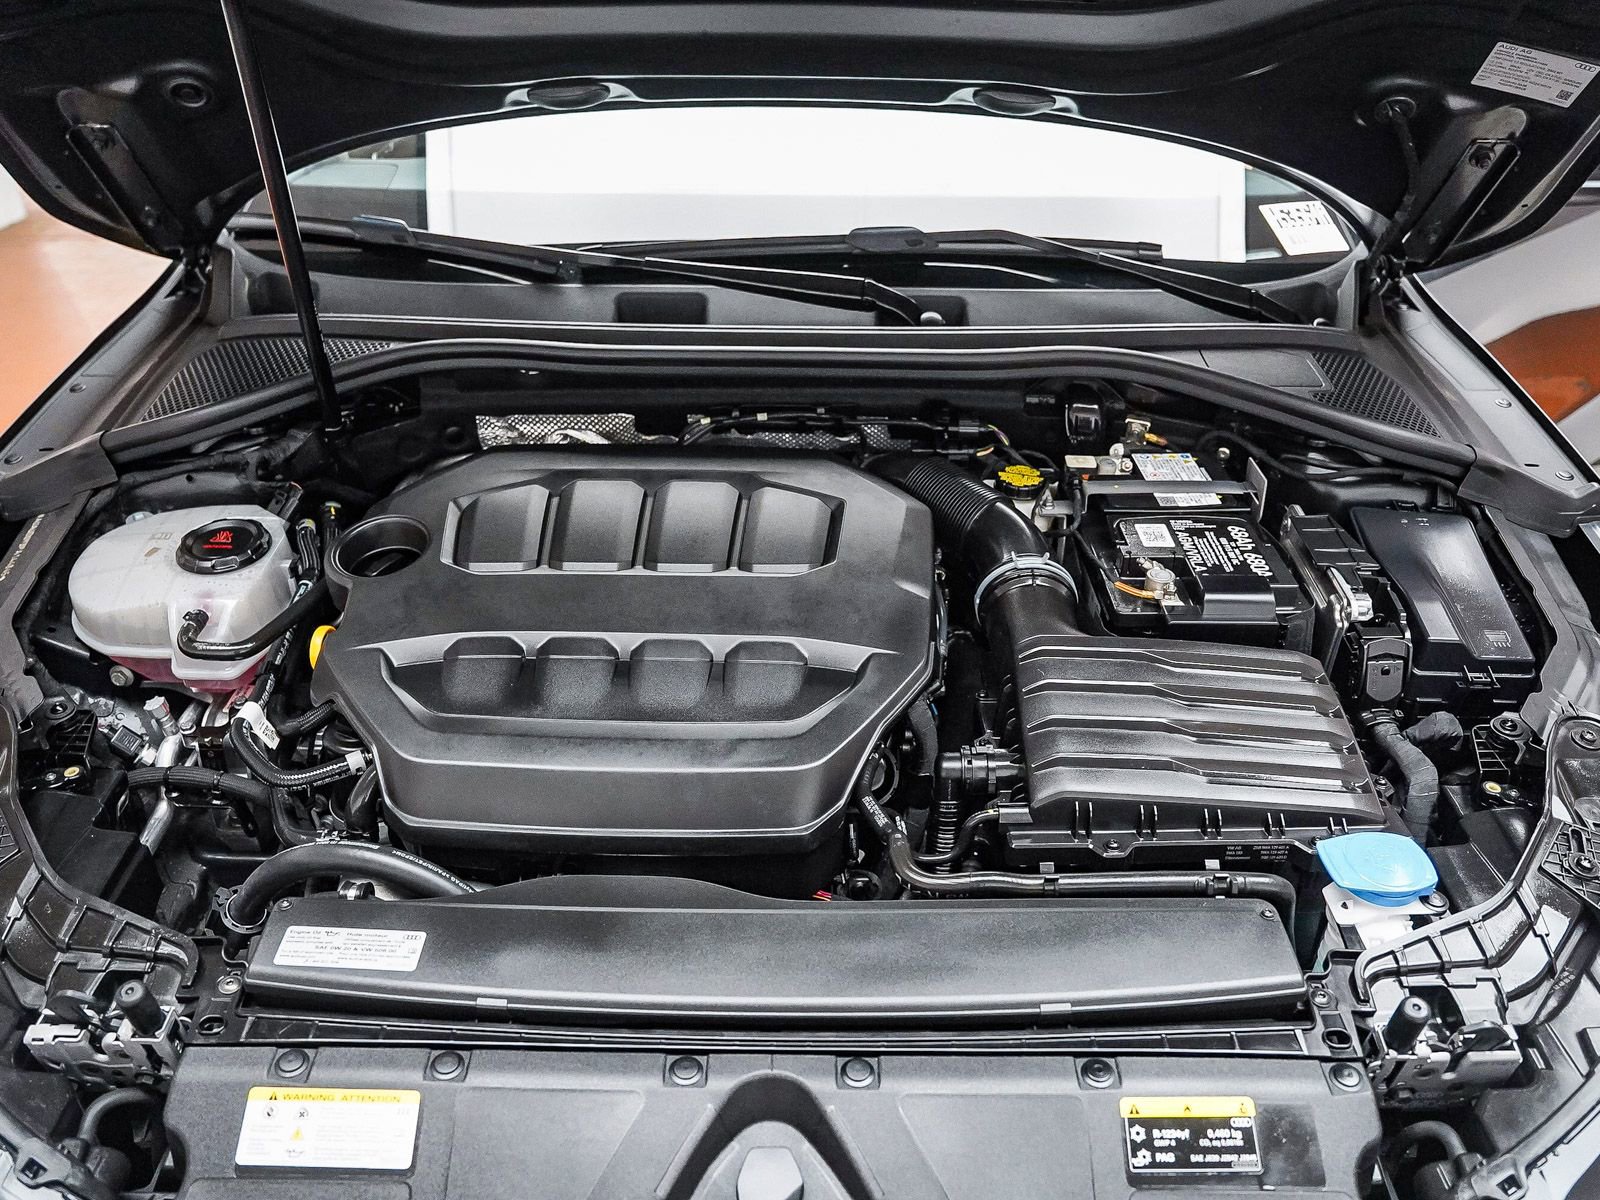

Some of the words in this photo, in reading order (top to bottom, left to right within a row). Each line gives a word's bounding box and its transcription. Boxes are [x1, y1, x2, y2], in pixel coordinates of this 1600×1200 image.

[1498, 44, 1518, 52] AUDI
[1227, 526, 1255, 550] 68Ah
[1243, 552, 1273, 577] 680A
[283, 1093, 336, 1101] WARNING
[341, 1094, 402, 1103] ATTENTION
[1155, 1152, 1176, 1162] PAG
